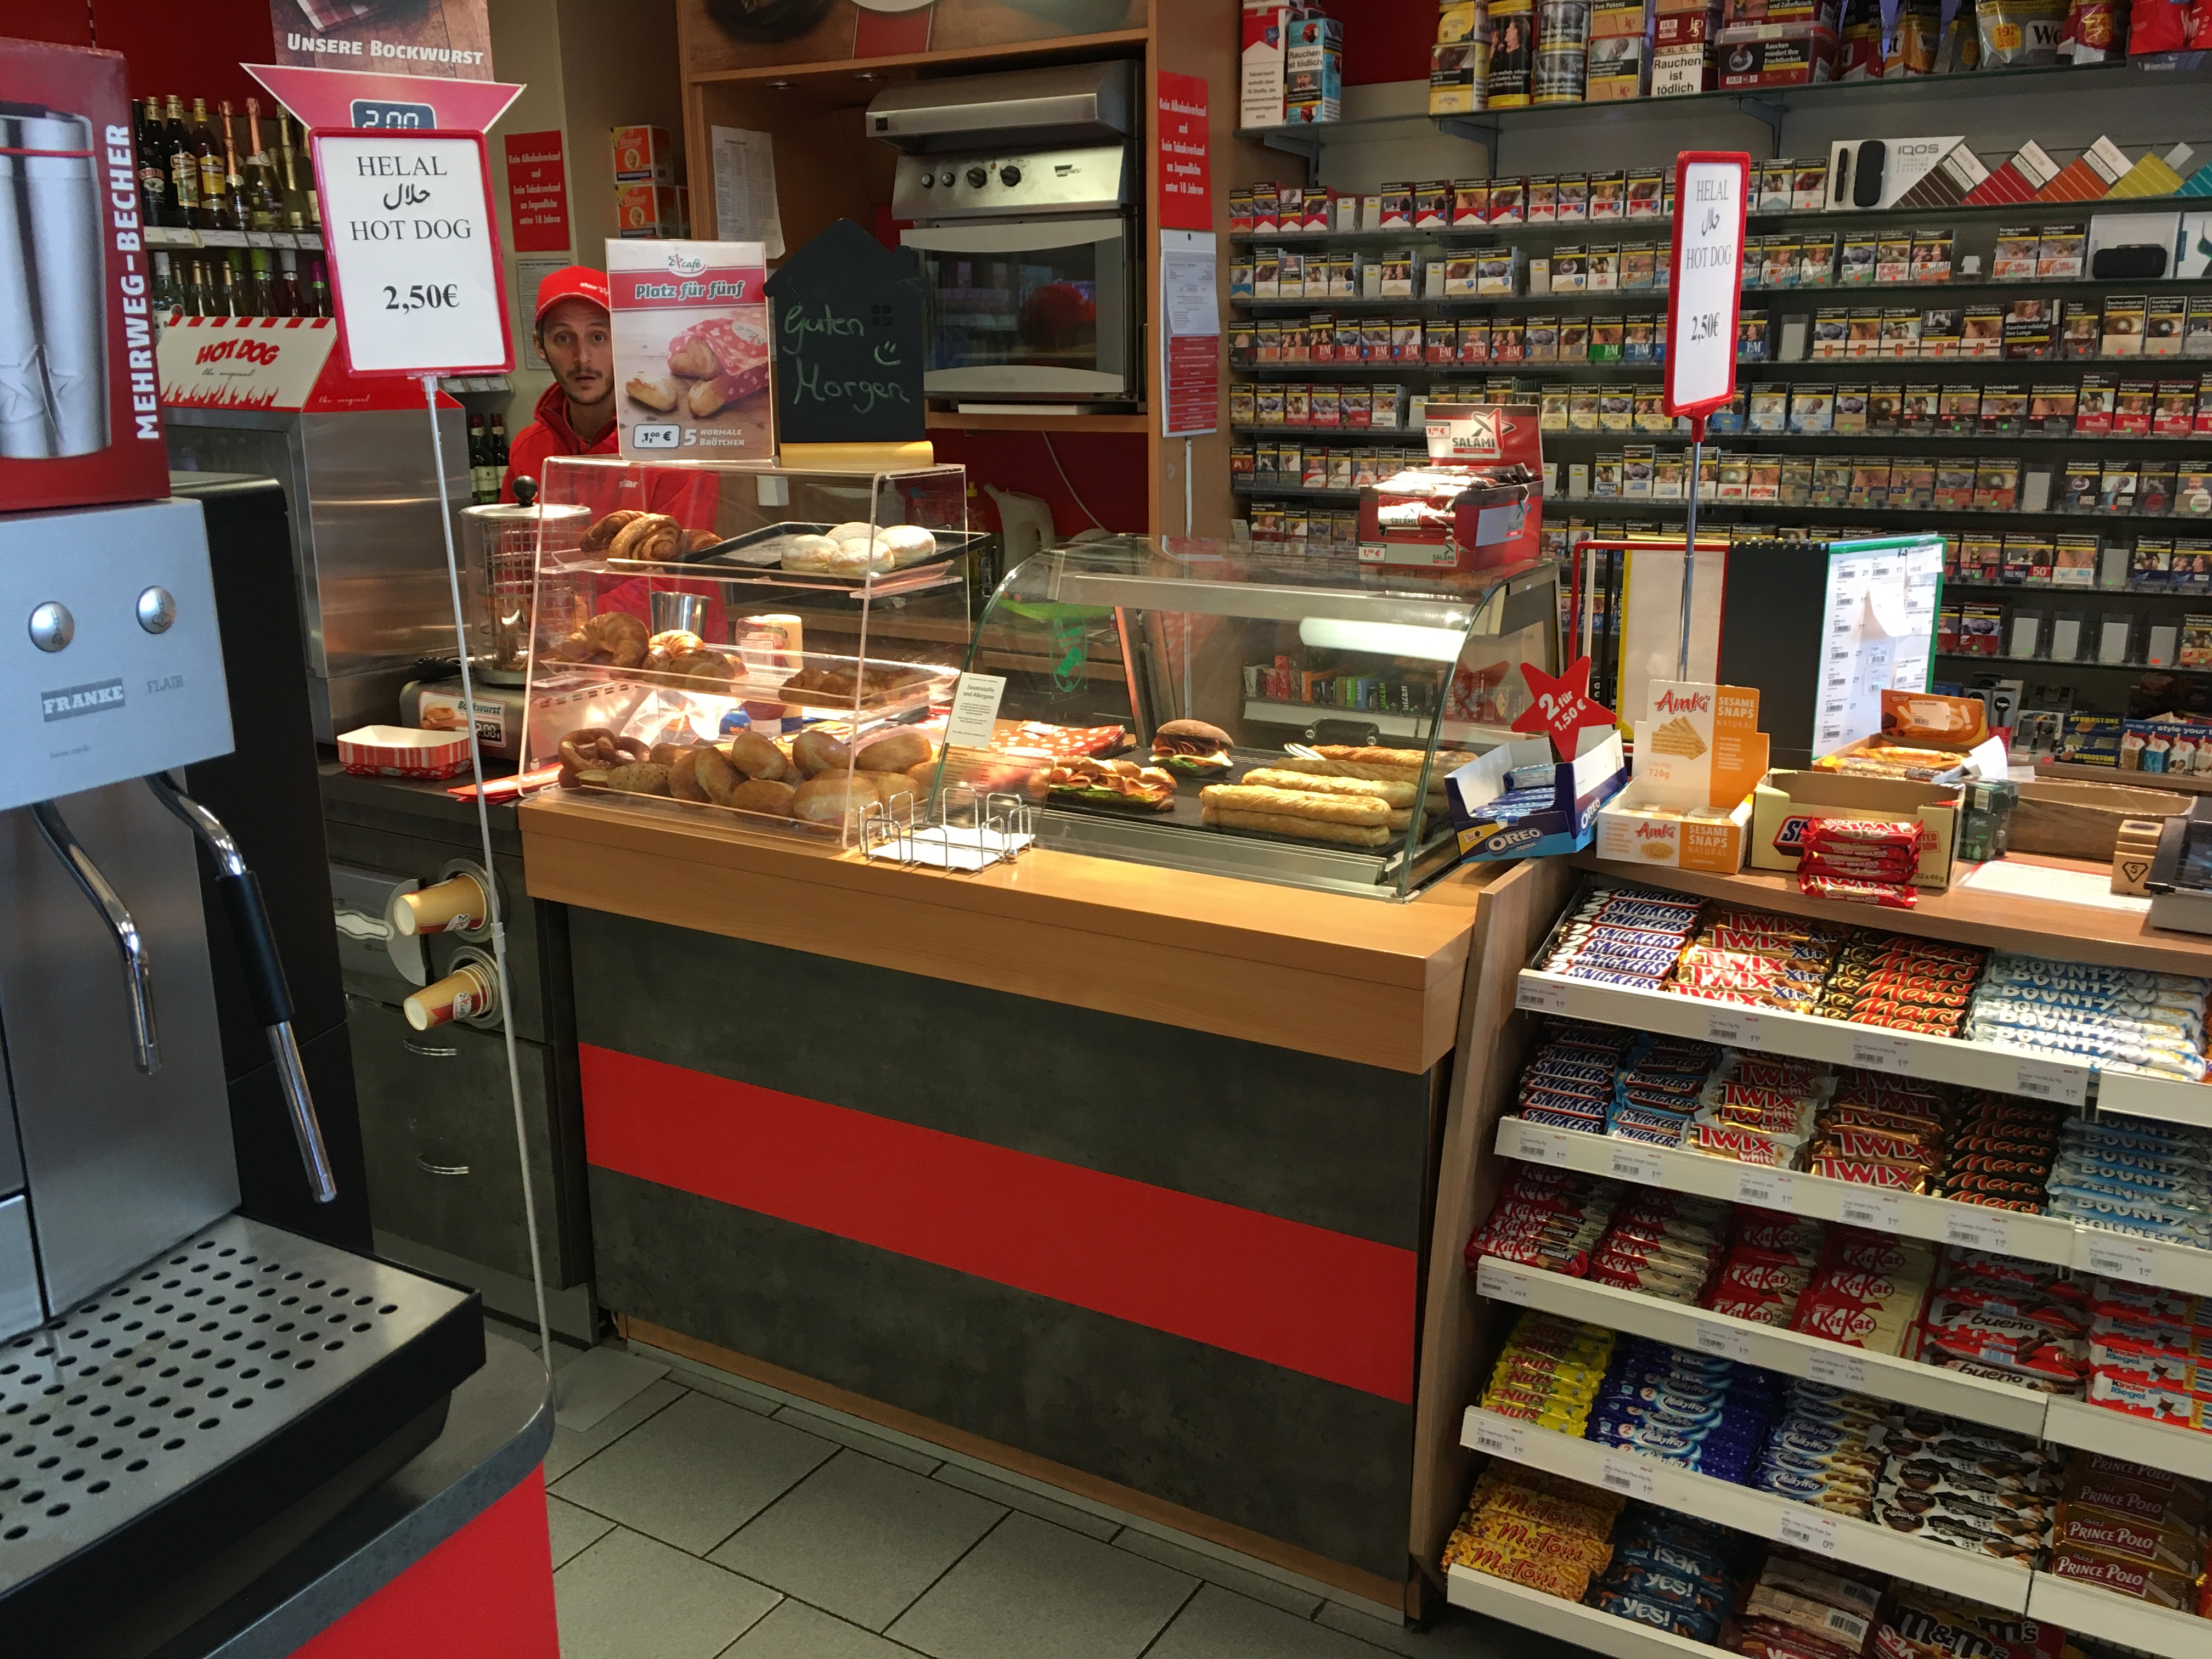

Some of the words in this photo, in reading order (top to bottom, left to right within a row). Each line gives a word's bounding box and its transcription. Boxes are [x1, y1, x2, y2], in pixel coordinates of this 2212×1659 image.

[1289, 50, 1321, 59] Rauchen
[1297, 59, 1323, 67] tödlich
[1654, 57, 1701, 70] Rauchen
[1669, 71, 1683, 80] ist
[1657, 82, 1694, 94] tödlich
[1898, 144, 1939, 155] IQOS
[356, 156, 447, 176] HELAL
[1180, 182, 1186, 193] 18
[1696, 179, 1729, 202] HELAL
[349, 219, 405, 240] HOT
[414, 219, 471, 240] DOG
[534, 215, 542, 223] 18
[1686, 247, 1709, 269] HOT
[1711, 245, 1731, 266] DOG
[106, 124, 160, 439] MEHRWEG-BECHER
[635, 284, 676, 299] Platz
[678, 281, 706, 301] für
[707, 280, 745, 300] fünf
[383, 284, 459, 314] 2,50€
[782, 303, 864, 354] Guten
[1691, 312, 1720, 346] 2,50€
[195, 338, 239, 365] HOT
[235, 339, 280, 365] DOG
[793, 357, 910, 413] Morgen
[684, 428, 697, 446] 5
[699, 437, 744, 446] BRÖTCHEN
[1452, 438, 1494, 448] SALAMI
[43, 685, 123, 714] FRANKE
[147, 675, 184, 693] FLAIR
[1539, 693, 1560, 720] 2
[1558, 690, 1573, 710] für
[1719, 697, 1754, 707] SESAME
[458, 701, 502, 714] Bokwurst
[1554, 708, 1578, 731] 1,50
[1577, 698, 1587, 711] €
[1718, 706, 1754, 718] SNAPS
[1717, 719, 1752, 729] NATURAL
[2158, 725, 2181, 733] style
[1649, 769, 1670, 780] 720g
[1581, 798, 1601, 828] OREO
[1487, 828, 1542, 852] OREO
[1689, 825, 1728, 836] SESAME
[1689, 834, 1728, 848] SNAPS
[1916, 872, 1944, 882] 32x49g
[1609, 900, 1698, 921] SNICKERS
[1600, 912, 1689, 932] SNICKERS
[1593, 927, 1684, 948] SNICKERS
[1705, 927, 1797, 951] TWIX
[1589, 939, 1679, 962] SNICKERS
[1684, 963, 1776, 990] TWIX
[1869, 951, 1979, 981] Mars
[1855, 981, 1969, 1006] Mars
[2012, 970, 2126, 996] BOUNTY
[2002, 985, 2116, 1011] BOUNTY
[1851, 997, 1965, 1024] Mars
[1630, 1072, 1694, 1090] SNICKERS
[1722, 1081, 1797, 1110] TWIX
[1694, 1124, 1774, 1155] TWIX
[1954, 1135, 2051, 1158] Mars
[2081, 1165, 2187, 1192] BOUNTY
[2076, 1199, 2184, 1226] BOUNTY
[1542, 1226, 1574, 1238] CHUNKY
[1490, 1240, 1538, 1261] KitKat
[1540, 1248, 1572, 1260] CHUNKY
[1733, 1266, 1791, 1289] KitKat
[1832, 1274, 1894, 1299] KitKat
[1812, 1308, 1877, 1337] KitKat
[1971, 1312, 2035, 1331] bueno
[1513, 1353, 1556, 1372] Nuts
[1958, 1362, 2023, 1384] bueno
[1503, 1388, 1545, 1403] Nuts
[2111, 1386, 2146, 1400] Riegel
[2069, 1521, 2115, 1541] PRINCE
[2117, 1528, 2154, 1549] POLO
[2058, 1556, 2103, 1576] PRINCE
[2106, 1564, 2143, 1585] POLO
